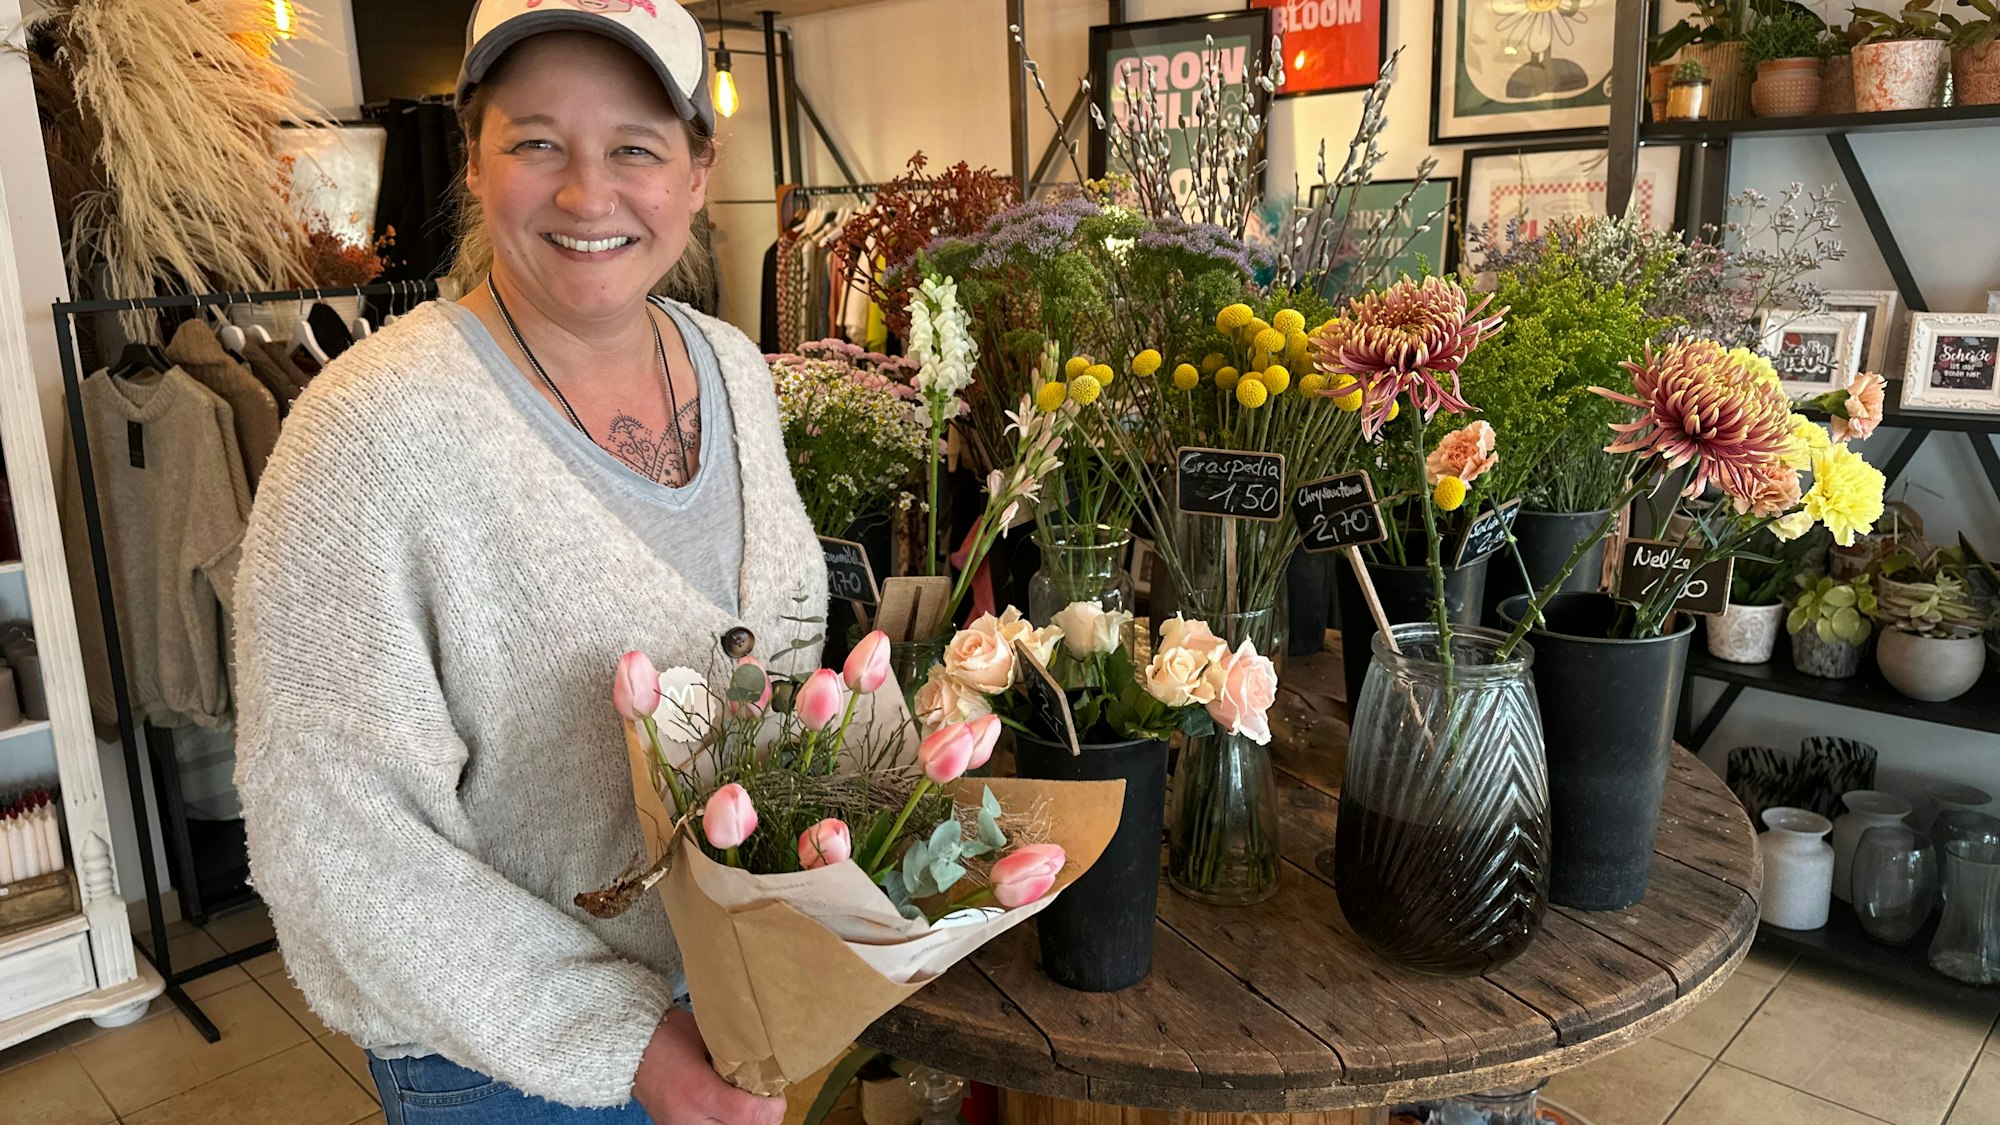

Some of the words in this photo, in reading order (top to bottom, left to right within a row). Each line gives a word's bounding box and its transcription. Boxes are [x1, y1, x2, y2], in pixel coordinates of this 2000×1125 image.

[1272, 0, 1361, 35] BLOOM
[1112, 46, 1246, 93] GROW
[1208, 482, 1279, 513] 1,50
